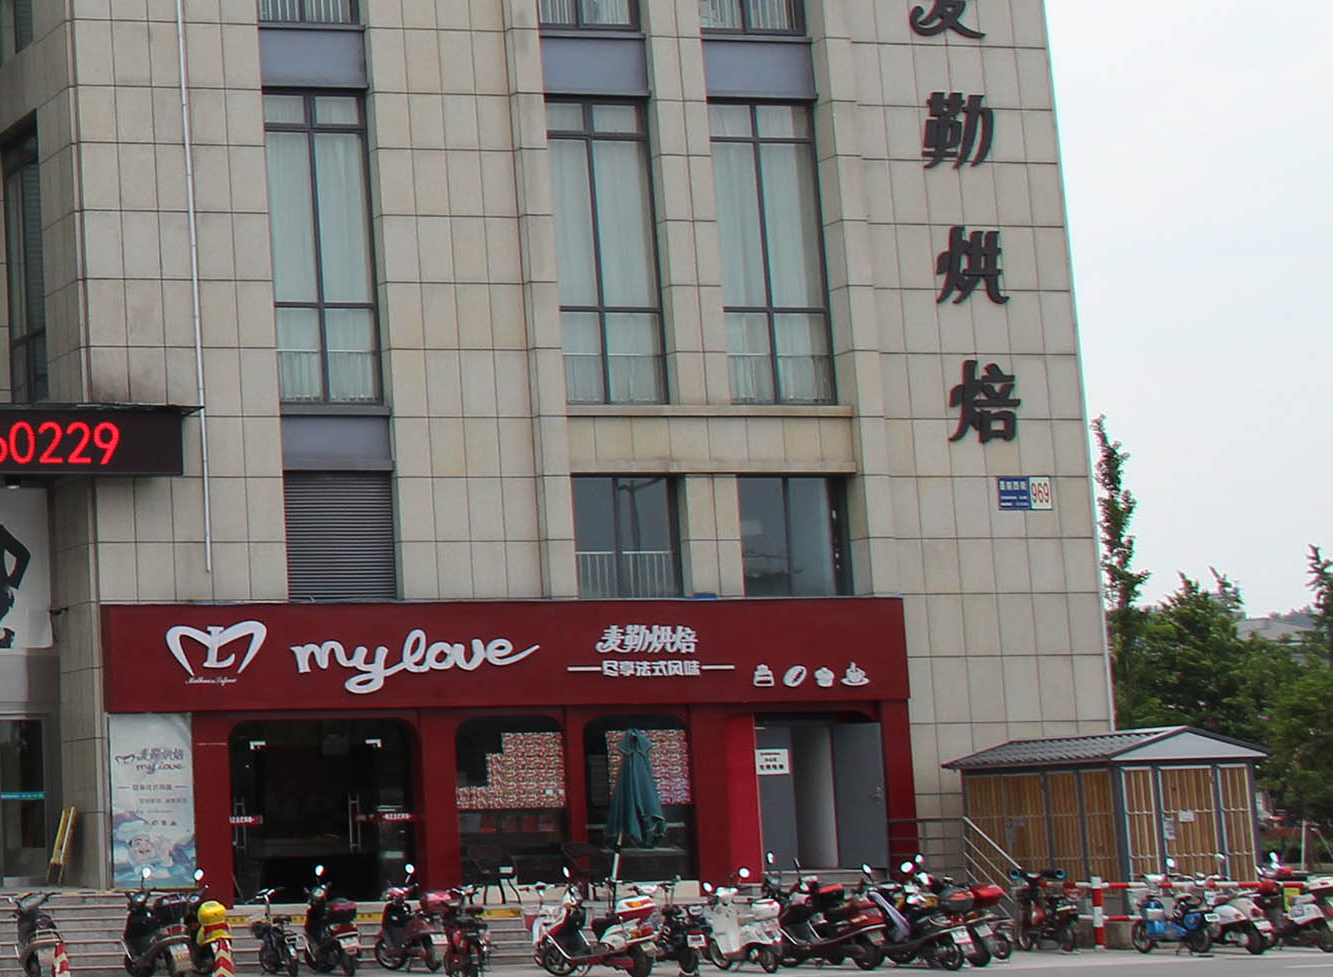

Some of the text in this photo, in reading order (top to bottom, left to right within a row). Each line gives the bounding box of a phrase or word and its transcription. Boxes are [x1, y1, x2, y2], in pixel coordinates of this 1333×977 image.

[595, 624, 699, 654] 麦勒烘焙
[601, 659, 702, 677] 尽享法式风味
